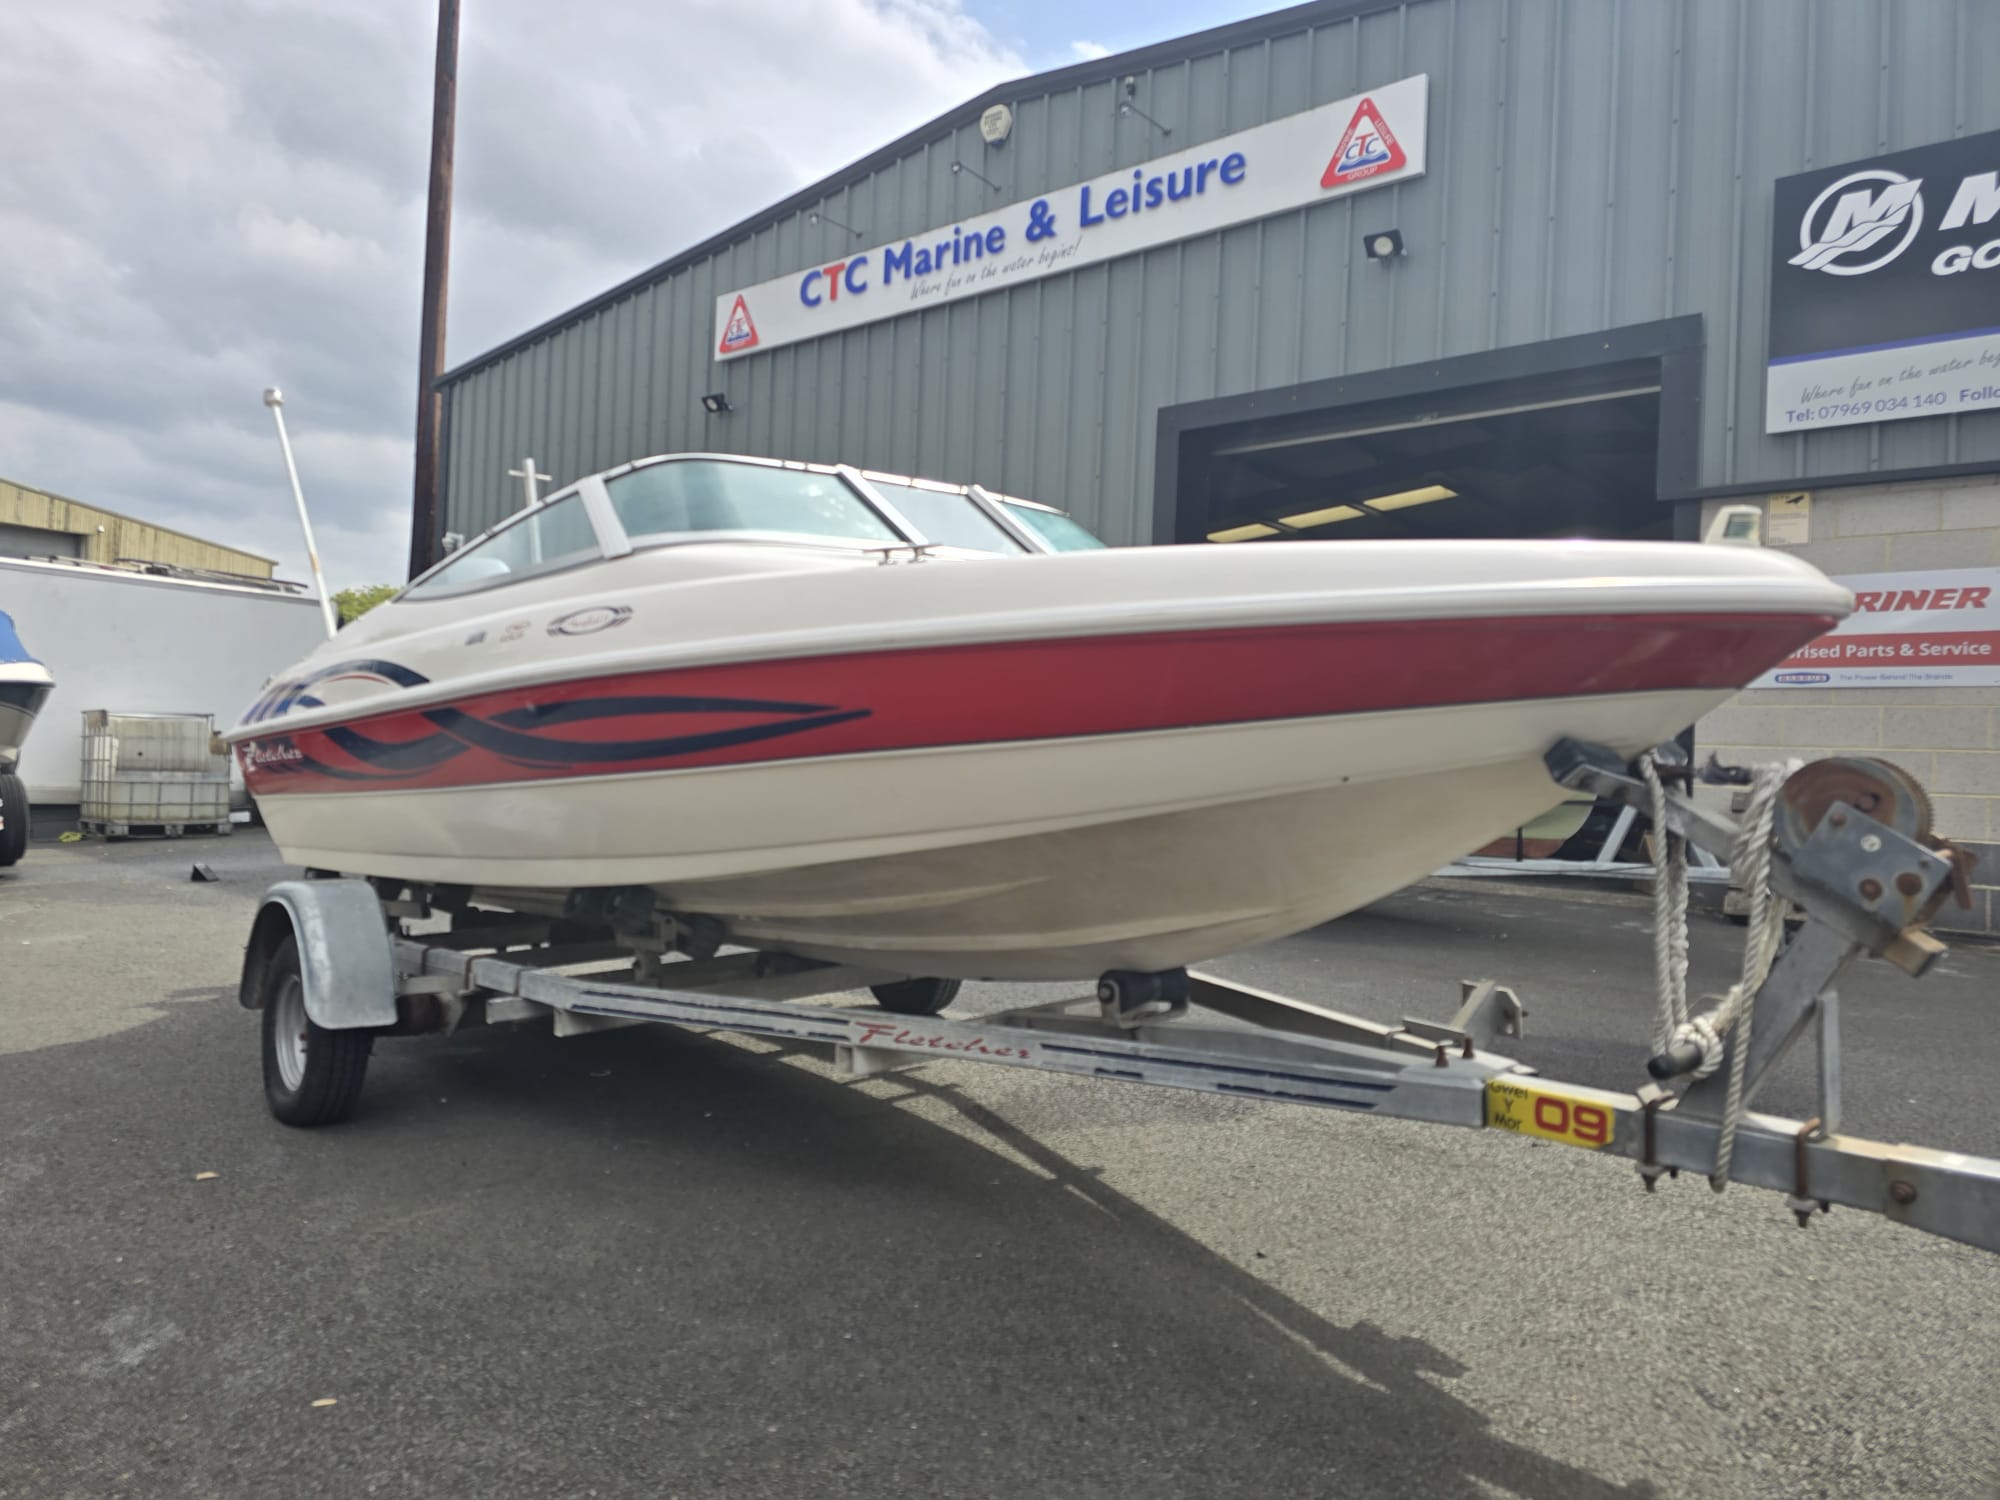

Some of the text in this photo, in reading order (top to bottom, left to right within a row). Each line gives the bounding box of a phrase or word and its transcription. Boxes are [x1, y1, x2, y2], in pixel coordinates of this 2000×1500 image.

[1345, 132, 1379, 160] CTC
[800, 151, 1247, 307] CTC Marine & Leisure
[910, 277, 941, 300] Where
[944, 273, 961, 296] fun
[981, 262, 997, 279] the
[1002, 256, 1034, 274] water
[1800, 386, 1844, 405] Where
[1850, 376, 1873, 398] fun
[1878, 376, 1894, 387] on
[1900, 365, 1922, 381] the
[1929, 358, 1973, 376] water
[1785, 409, 1815, 423] Tel:
[1818, 401, 1872, 420] 07969
[1875, 396, 1908, 413] 034
[1914, 391, 1948, 408] 140
[1852, 587, 1992, 613] RINER
[1789, 641, 1992, 659] rised Parts & Service
[1494, 1111, 1523, 1131] Mor
[1535, 1097, 1608, 1145] 09
